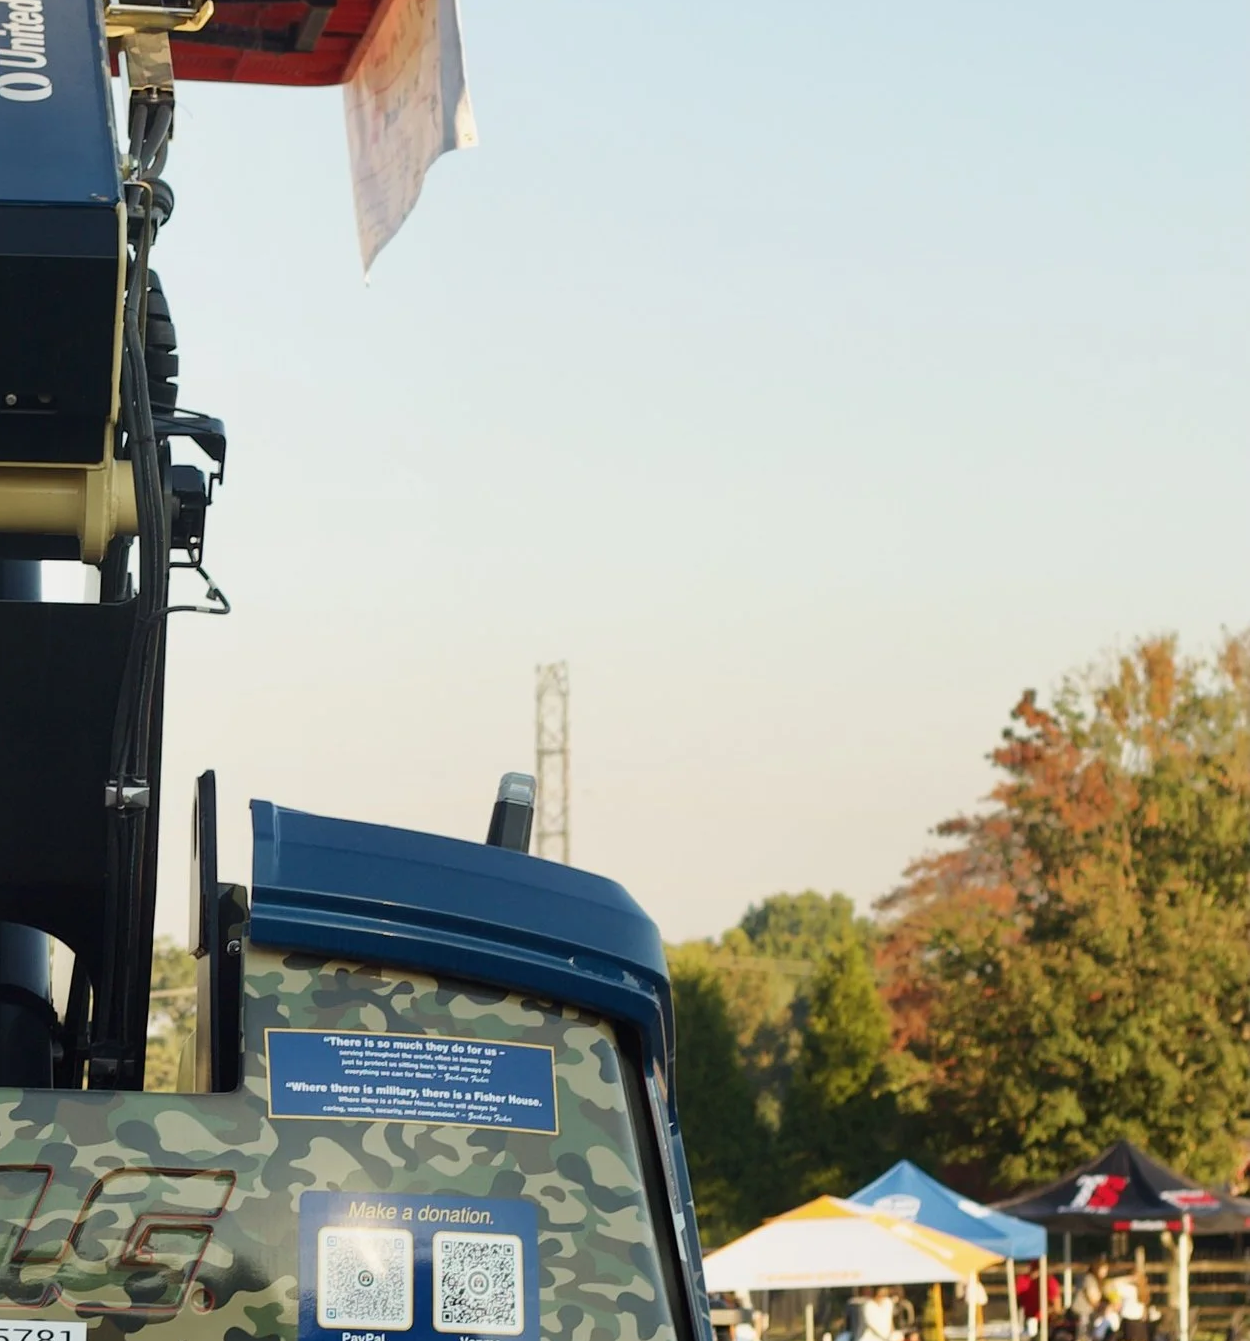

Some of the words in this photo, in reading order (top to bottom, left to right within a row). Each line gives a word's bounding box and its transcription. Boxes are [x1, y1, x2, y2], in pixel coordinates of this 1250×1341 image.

[364, 1038, 374, 1047] is
[393, 1041, 422, 1050] much
[425, 1042, 449, 1053] they
[451, 1044, 464, 1053] do
[467, 1045, 482, 1055] for
[344, 1069, 379, 1077] everything
[331, 1083, 360, 1093] there
[363, 1084, 373, 1094] is
[376, 1085, 419, 1098] military,
[422, 1088, 450, 1098] there
[453, 1090, 462, 1099] is
[465, 1092, 471, 1100] a
[474, 1091, 506, 1103] Fisher
[508, 1095, 542, 1107] House.
[1076, 1175, 1129, 1209] TS
[349, 1202, 396, 1219] Make
[402, 1207, 412, 1221] a
[418, 1205, 494, 1225] donation.
